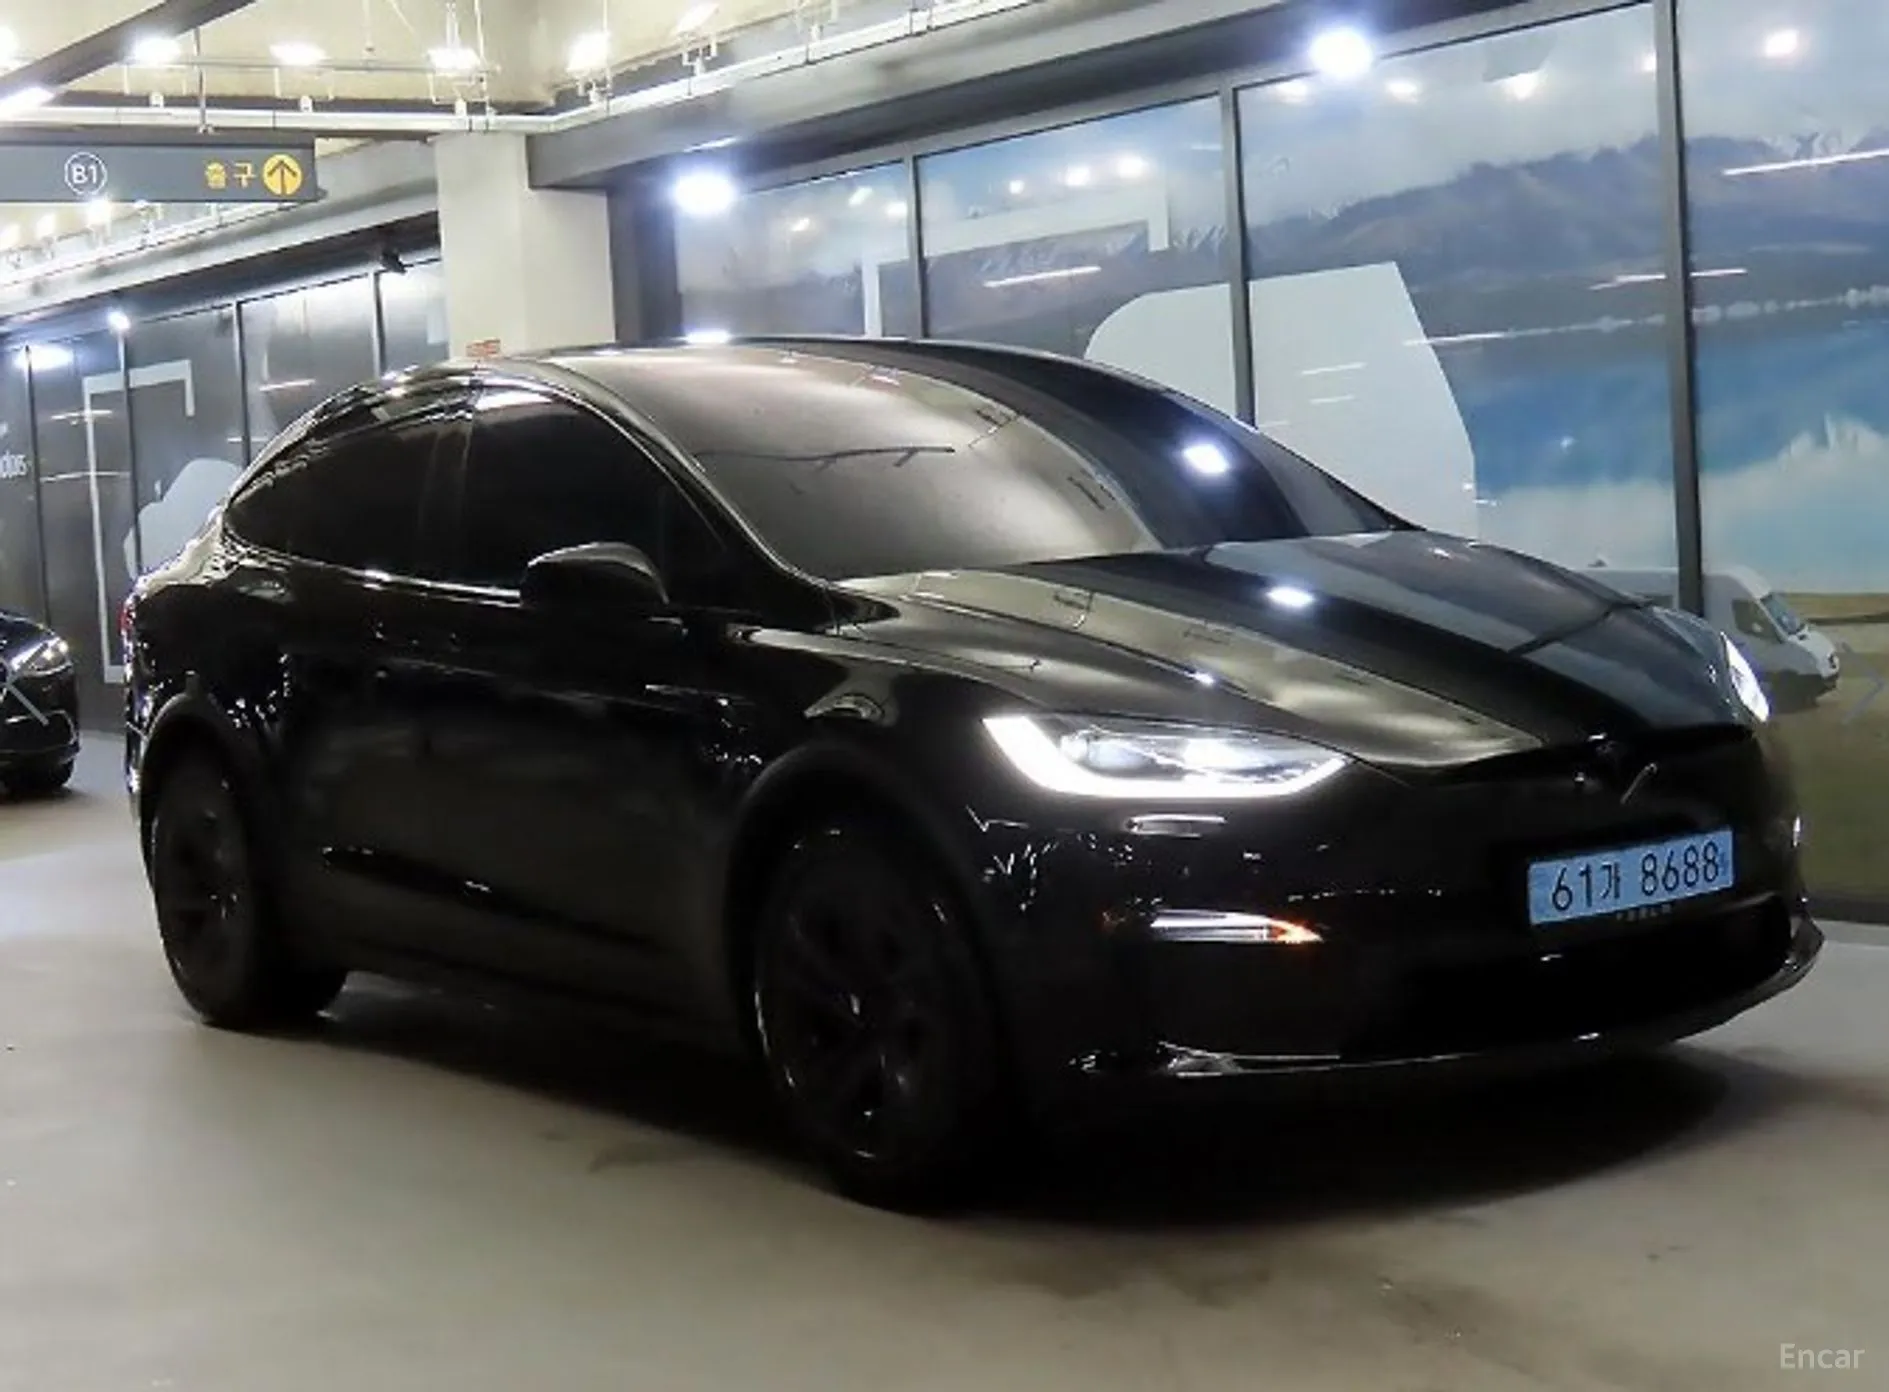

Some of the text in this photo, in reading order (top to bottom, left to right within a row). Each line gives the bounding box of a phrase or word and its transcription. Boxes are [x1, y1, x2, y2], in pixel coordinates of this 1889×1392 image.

[72, 164, 98, 185] B1
[1552, 840, 1719, 911] 61가 8688
